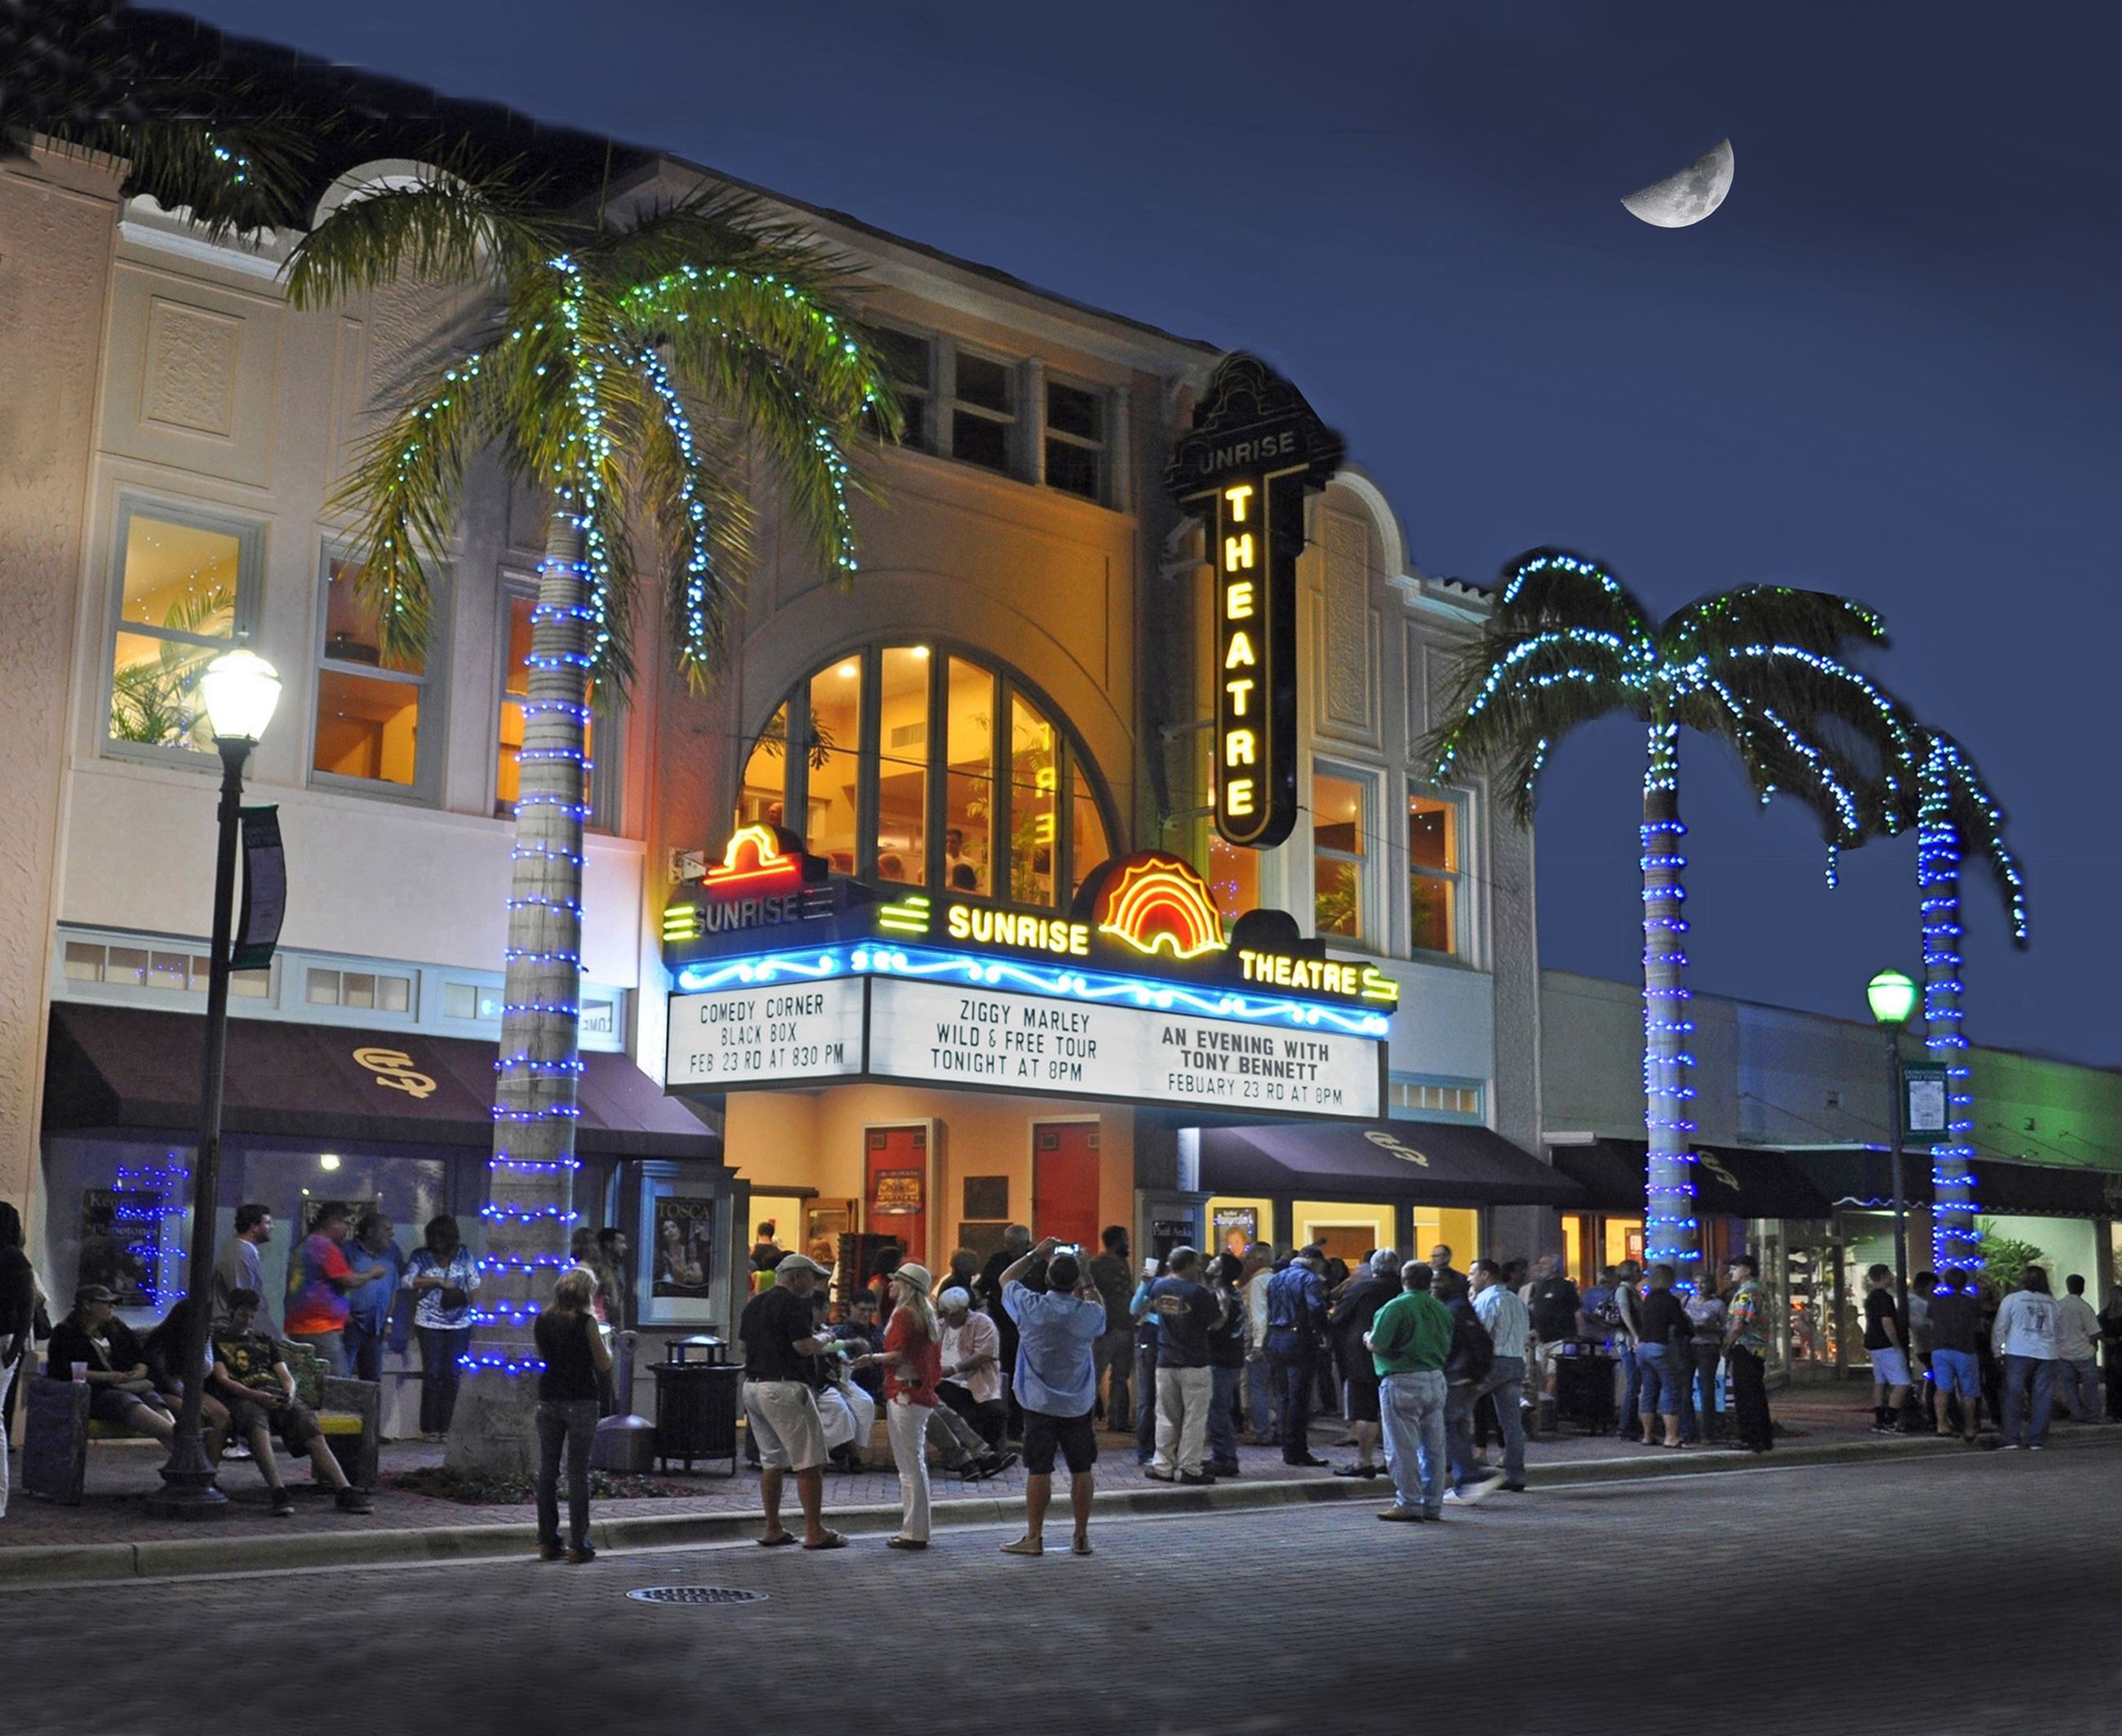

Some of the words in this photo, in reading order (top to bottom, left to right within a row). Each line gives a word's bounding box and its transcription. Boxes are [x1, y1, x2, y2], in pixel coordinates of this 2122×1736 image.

[1225, 485, 1255, 817] THEATRE
[694, 893, 799, 934] SUNRISE
[948, 904, 1090, 957] SUNRISE
[1238, 949, 1357, 995] THEATRE
[700, 1001, 756, 1023] COMEDY
[766, 994, 823, 1018] CORNER
[960, 1000, 1011, 1024] ZIGGY
[1023, 1007, 1090, 1033] MARLEY
[721, 1025, 761, 1046] BLACK
[770, 1022, 797, 1042] BOX
[936, 1023, 979, 1046] WILD
[988, 1028, 997, 1048] &
[1005, 1031, 1045, 1053] FREE
[1055, 1036, 1097, 1059] TOUR
[1161, 1027, 1187, 1046] AN
[1196, 1030, 1274, 1056] EVENING
[1284, 1040, 1330, 1062] WITH
[690, 1054, 714, 1073] FEB
[722, 1052, 738, 1071] 23
[744, 1050, 761, 1069] RD
[769, 1048, 785, 1068] AT
[792, 1046, 818, 1066] 830
[825, 1043, 845, 1064] PM
[930, 1048, 1007, 1074] TONIGHT
[1018, 1058, 1039, 1077] AT
[1049, 1060, 1082, 1081] 8PM
[1180, 1050, 1230, 1072] TONY
[1239, 1056, 1318, 1081] BENNETT
[1168, 1073, 1235, 1095] FEBUARY
[1243, 1080, 1259, 1098] 23
[1267, 1083, 1284, 1100] RD
[1290, 1086, 1307, 1102] AT
[1316, 1087, 1343, 1105] 8PM
[656, 1202, 710, 1220] TOSCA
